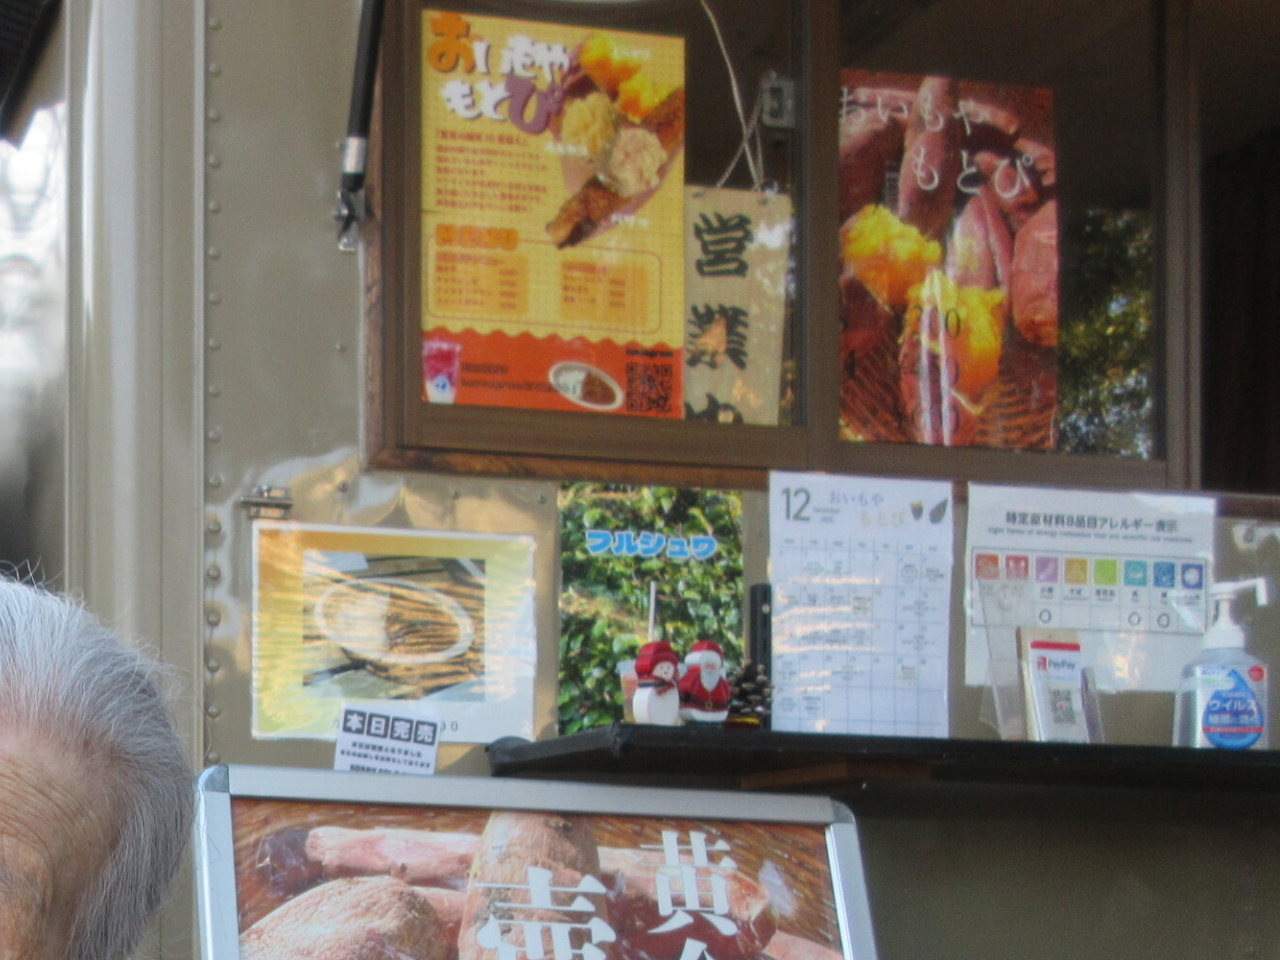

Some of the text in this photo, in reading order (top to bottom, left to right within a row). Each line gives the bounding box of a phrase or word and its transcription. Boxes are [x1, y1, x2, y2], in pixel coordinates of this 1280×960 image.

[782, 487, 811, 521] 12
[586, 530, 718, 559] フルシュワ
[343, 709, 437, 745] 本日完売
